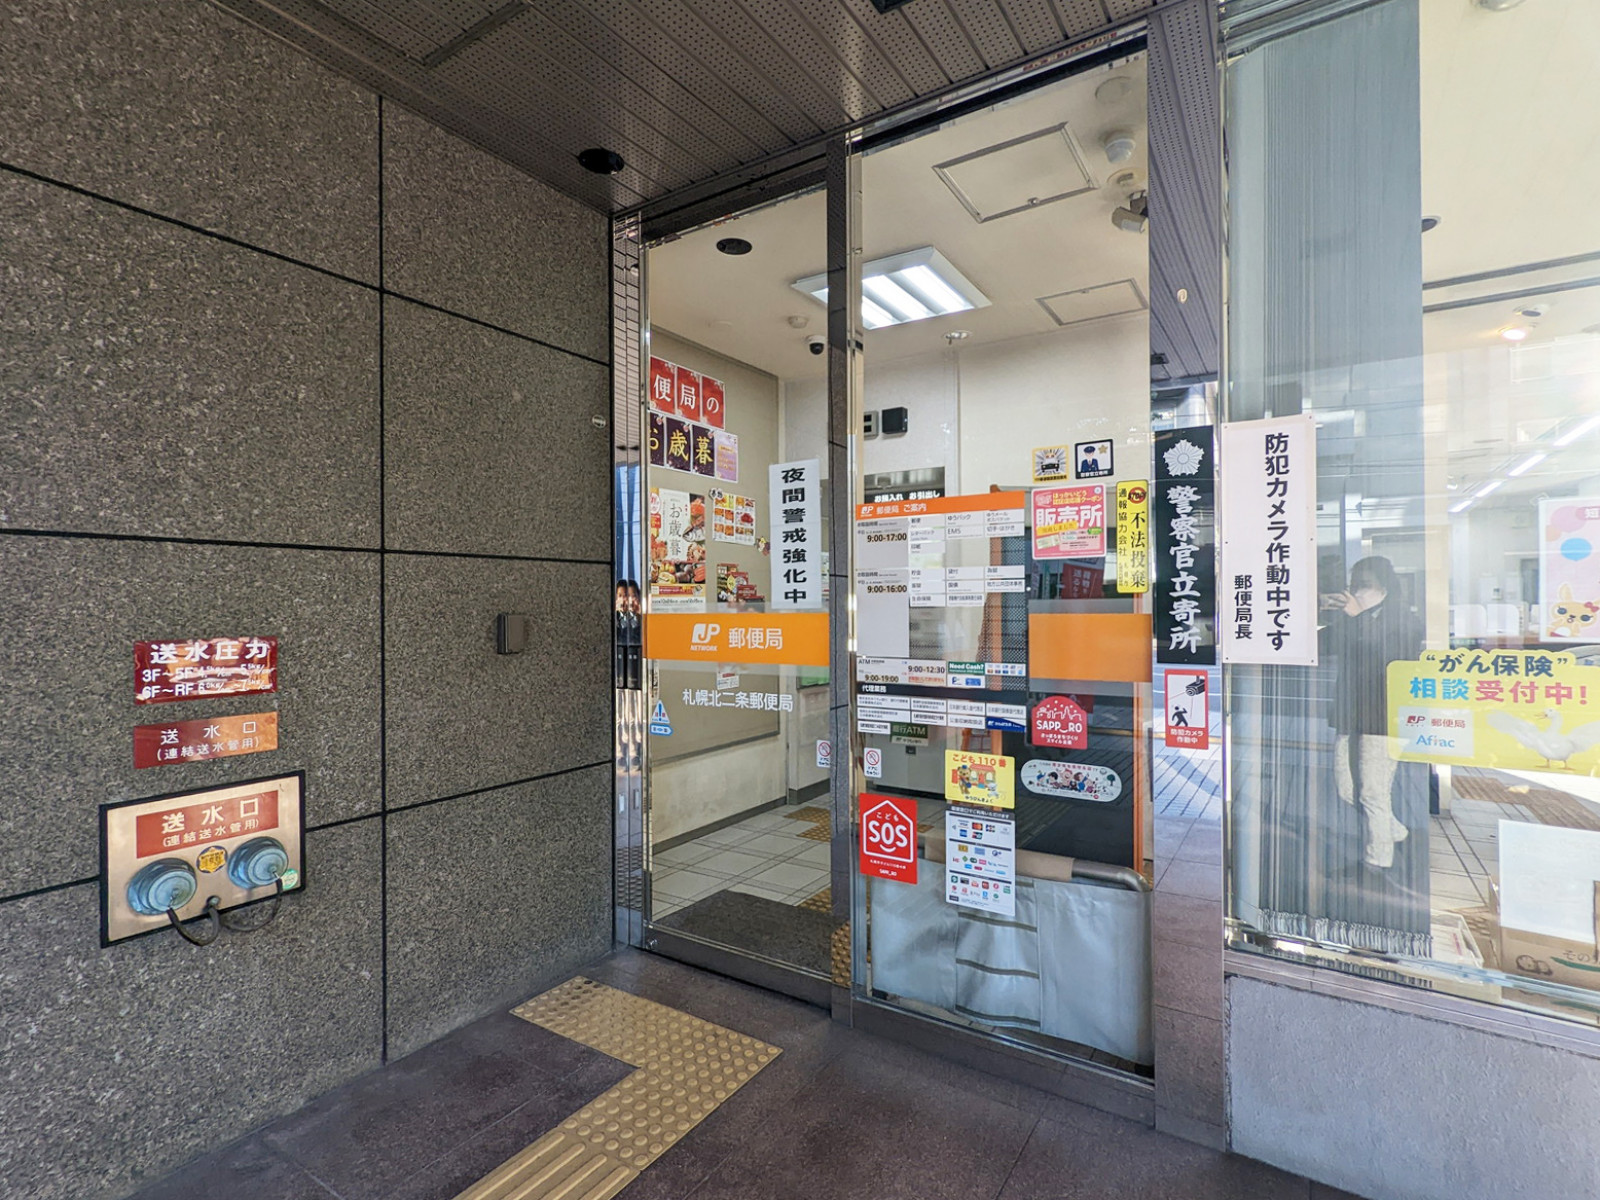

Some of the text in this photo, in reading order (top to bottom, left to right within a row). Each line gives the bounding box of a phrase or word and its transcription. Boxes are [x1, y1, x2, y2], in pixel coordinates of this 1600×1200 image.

[654, 374, 719, 414] 便局の
[903, 503, 927, 512] ご案内
[1036, 504, 1103, 528] 販売所
[781, 467, 807, 604] 夜間警戒強化中
[867, 533, 907, 542] 9:00-17:00
[1264, 433, 1291, 651] 防犯カメラ作動中です
[1130, 510, 1146, 588] 不法投棄
[1168, 485, 1201, 654] 警察官立寄所
[867, 585, 908, 594] 9:00-16:00
[1234, 574, 1252, 640] 郵便局長
[728, 627, 783, 650] 郵便局
[151, 639, 268, 664] 送水圧力
[864, 674, 899, 683] 9:00-19:00
[908, 665, 945, 674] 9:00-12:30
[682, 688, 794, 712] 札幌北二条郵便局
[161, 721, 256, 745] 送水口
[1170, 728, 1204, 737] 防犯カメラ
[1431, 718, 1465, 728] 郵便局
[161, 798, 258, 834] 送水口
[876, 811, 899, 821] こども
[868, 820, 908, 848] SOS
